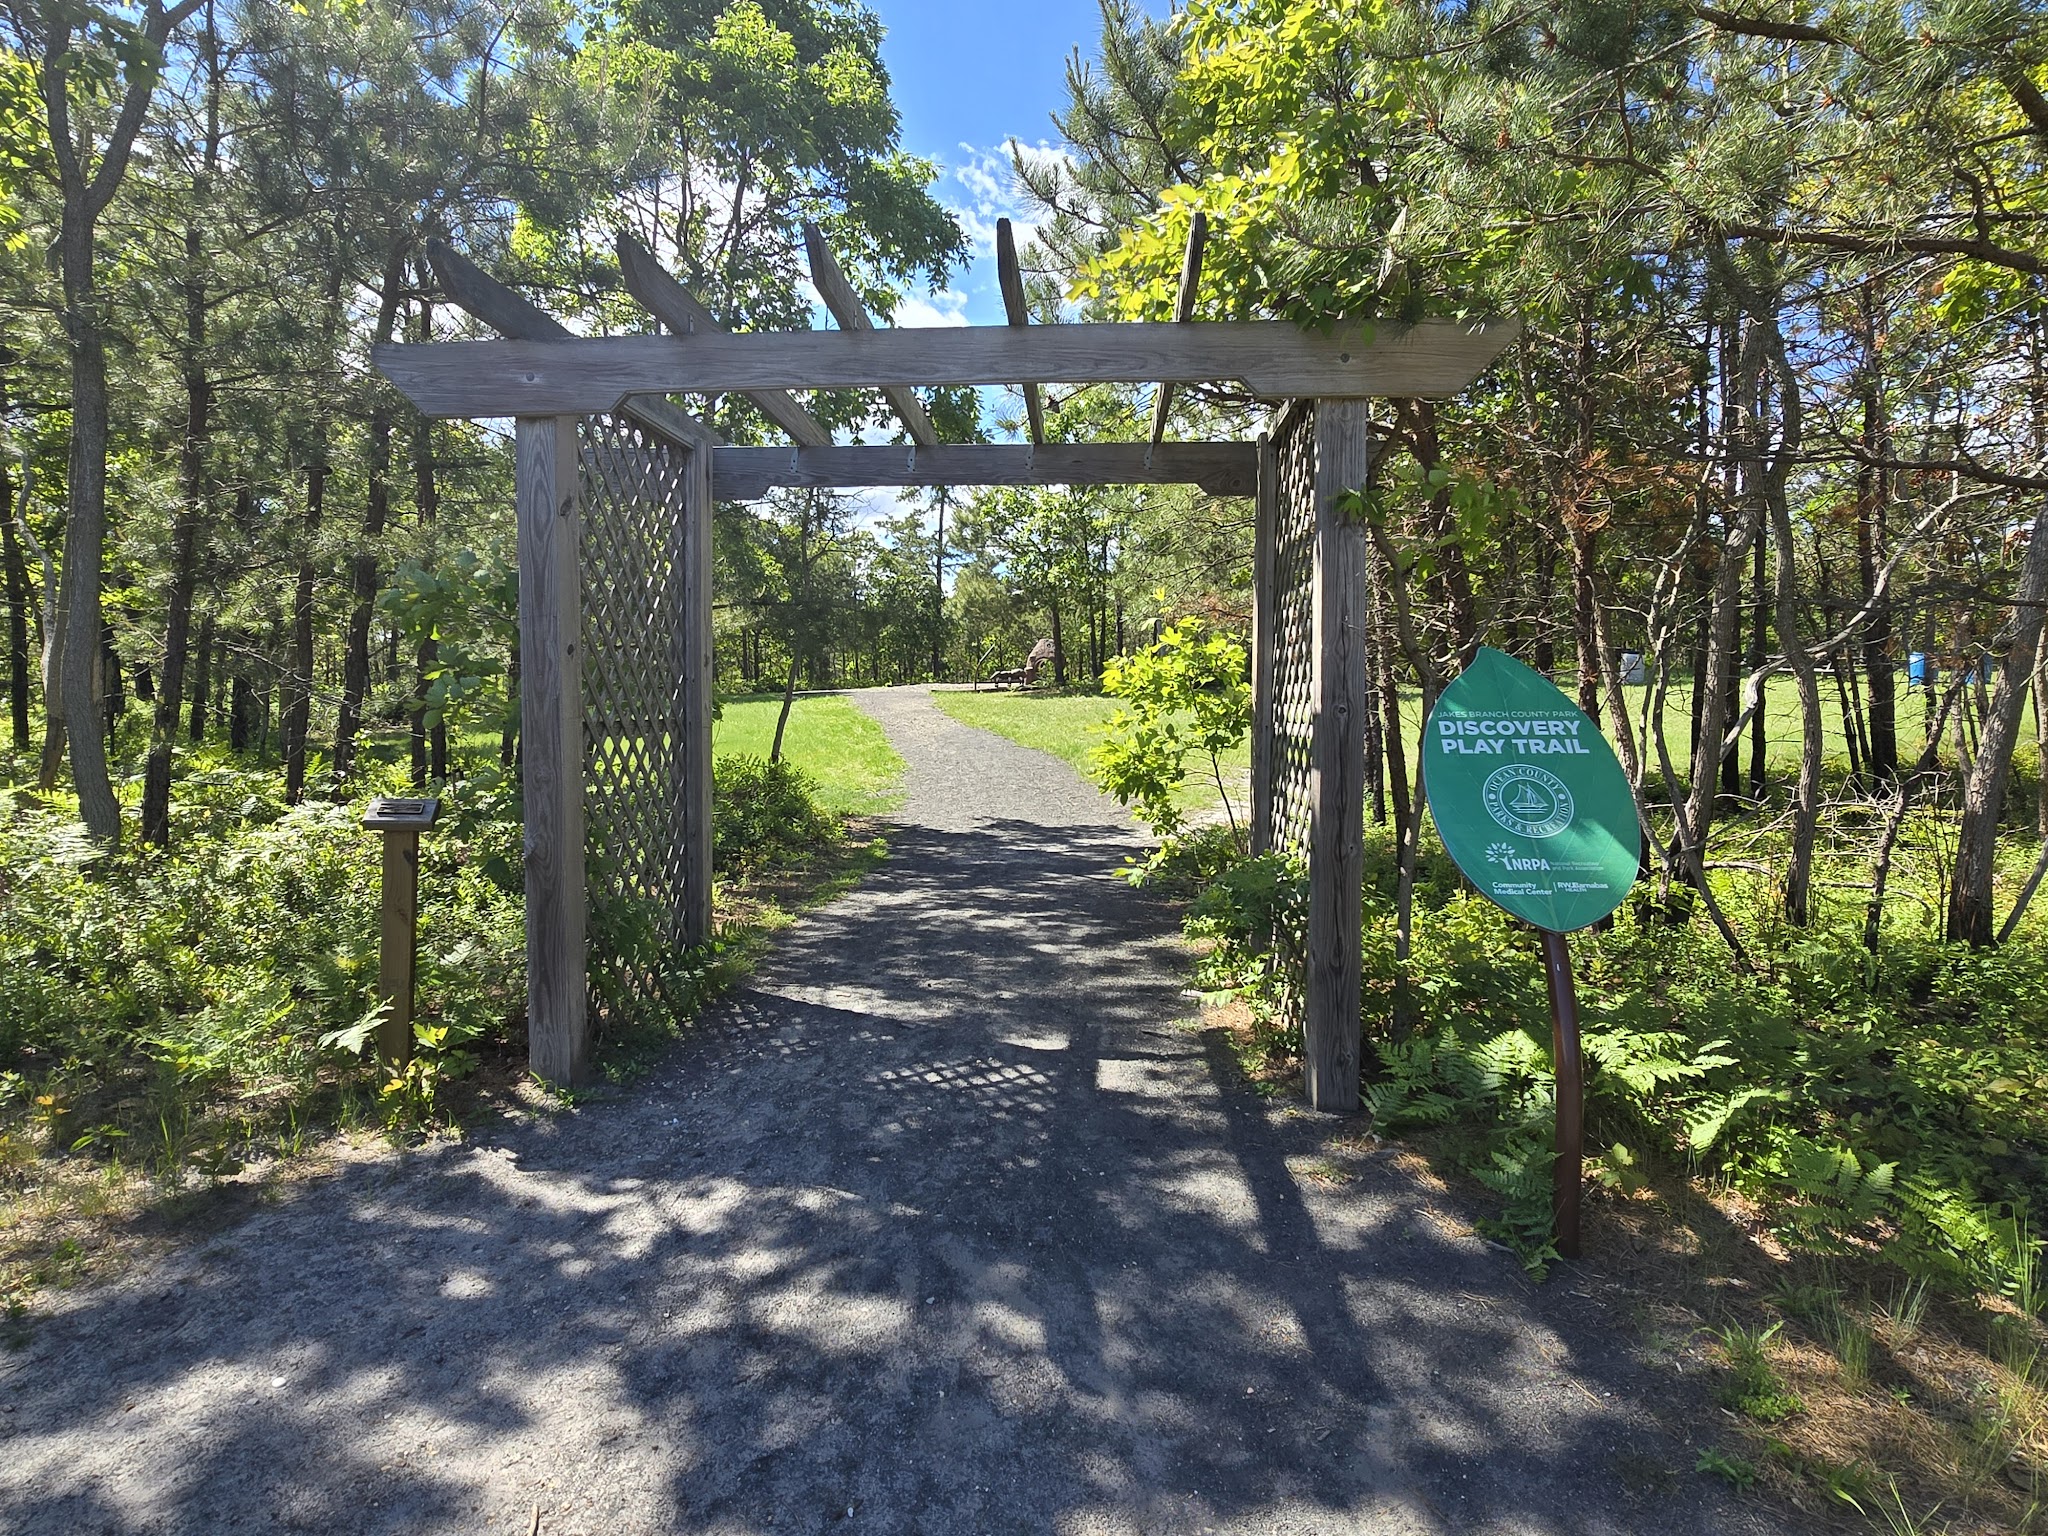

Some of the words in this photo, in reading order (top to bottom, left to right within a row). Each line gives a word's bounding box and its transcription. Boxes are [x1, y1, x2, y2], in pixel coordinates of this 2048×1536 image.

[1438, 720, 1580, 735] DISCOVERY
[1441, 739, 1505, 754] PLAY
[1511, 739, 1590, 754] TRAIL
[1489, 768, 1516, 791] OCEAN
[1518, 768, 1562, 790] COUNTY
[1489, 801, 1514, 826] PARKS
[1526, 802, 1569, 834] RECREATION
[1511, 858, 1551, 870] NRPA
